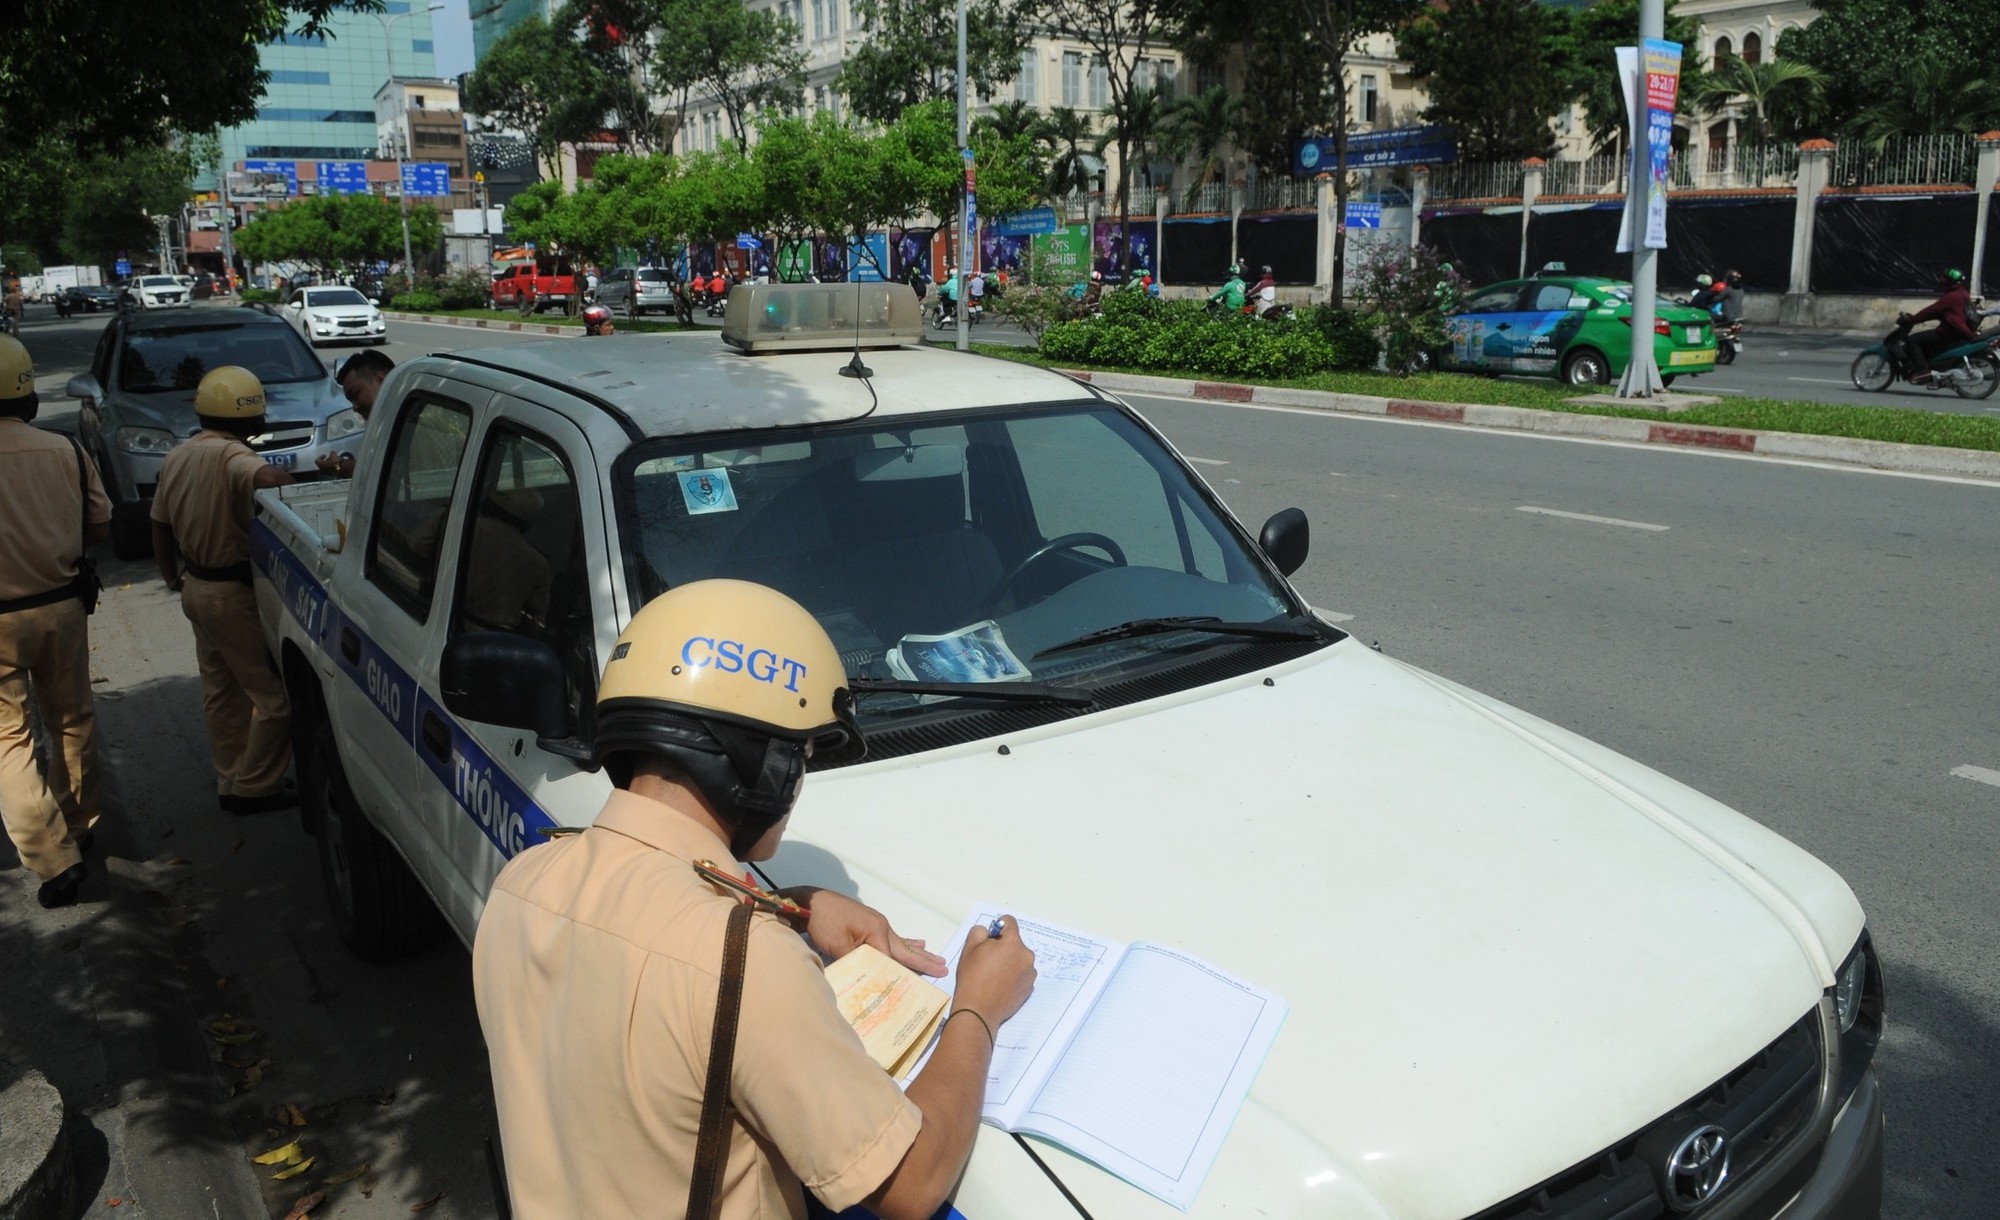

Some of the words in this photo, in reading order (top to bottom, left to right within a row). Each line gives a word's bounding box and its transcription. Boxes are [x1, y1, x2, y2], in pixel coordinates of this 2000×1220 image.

[1390, 152, 1396, 160] 2
[1528, 335, 1550, 344] ngon
[681, 636, 807, 693] CSGT
[294, 585, 318, 631] SÁT
[366, 657, 400, 723] GIAO
[452, 748, 525, 855] THÔNG
